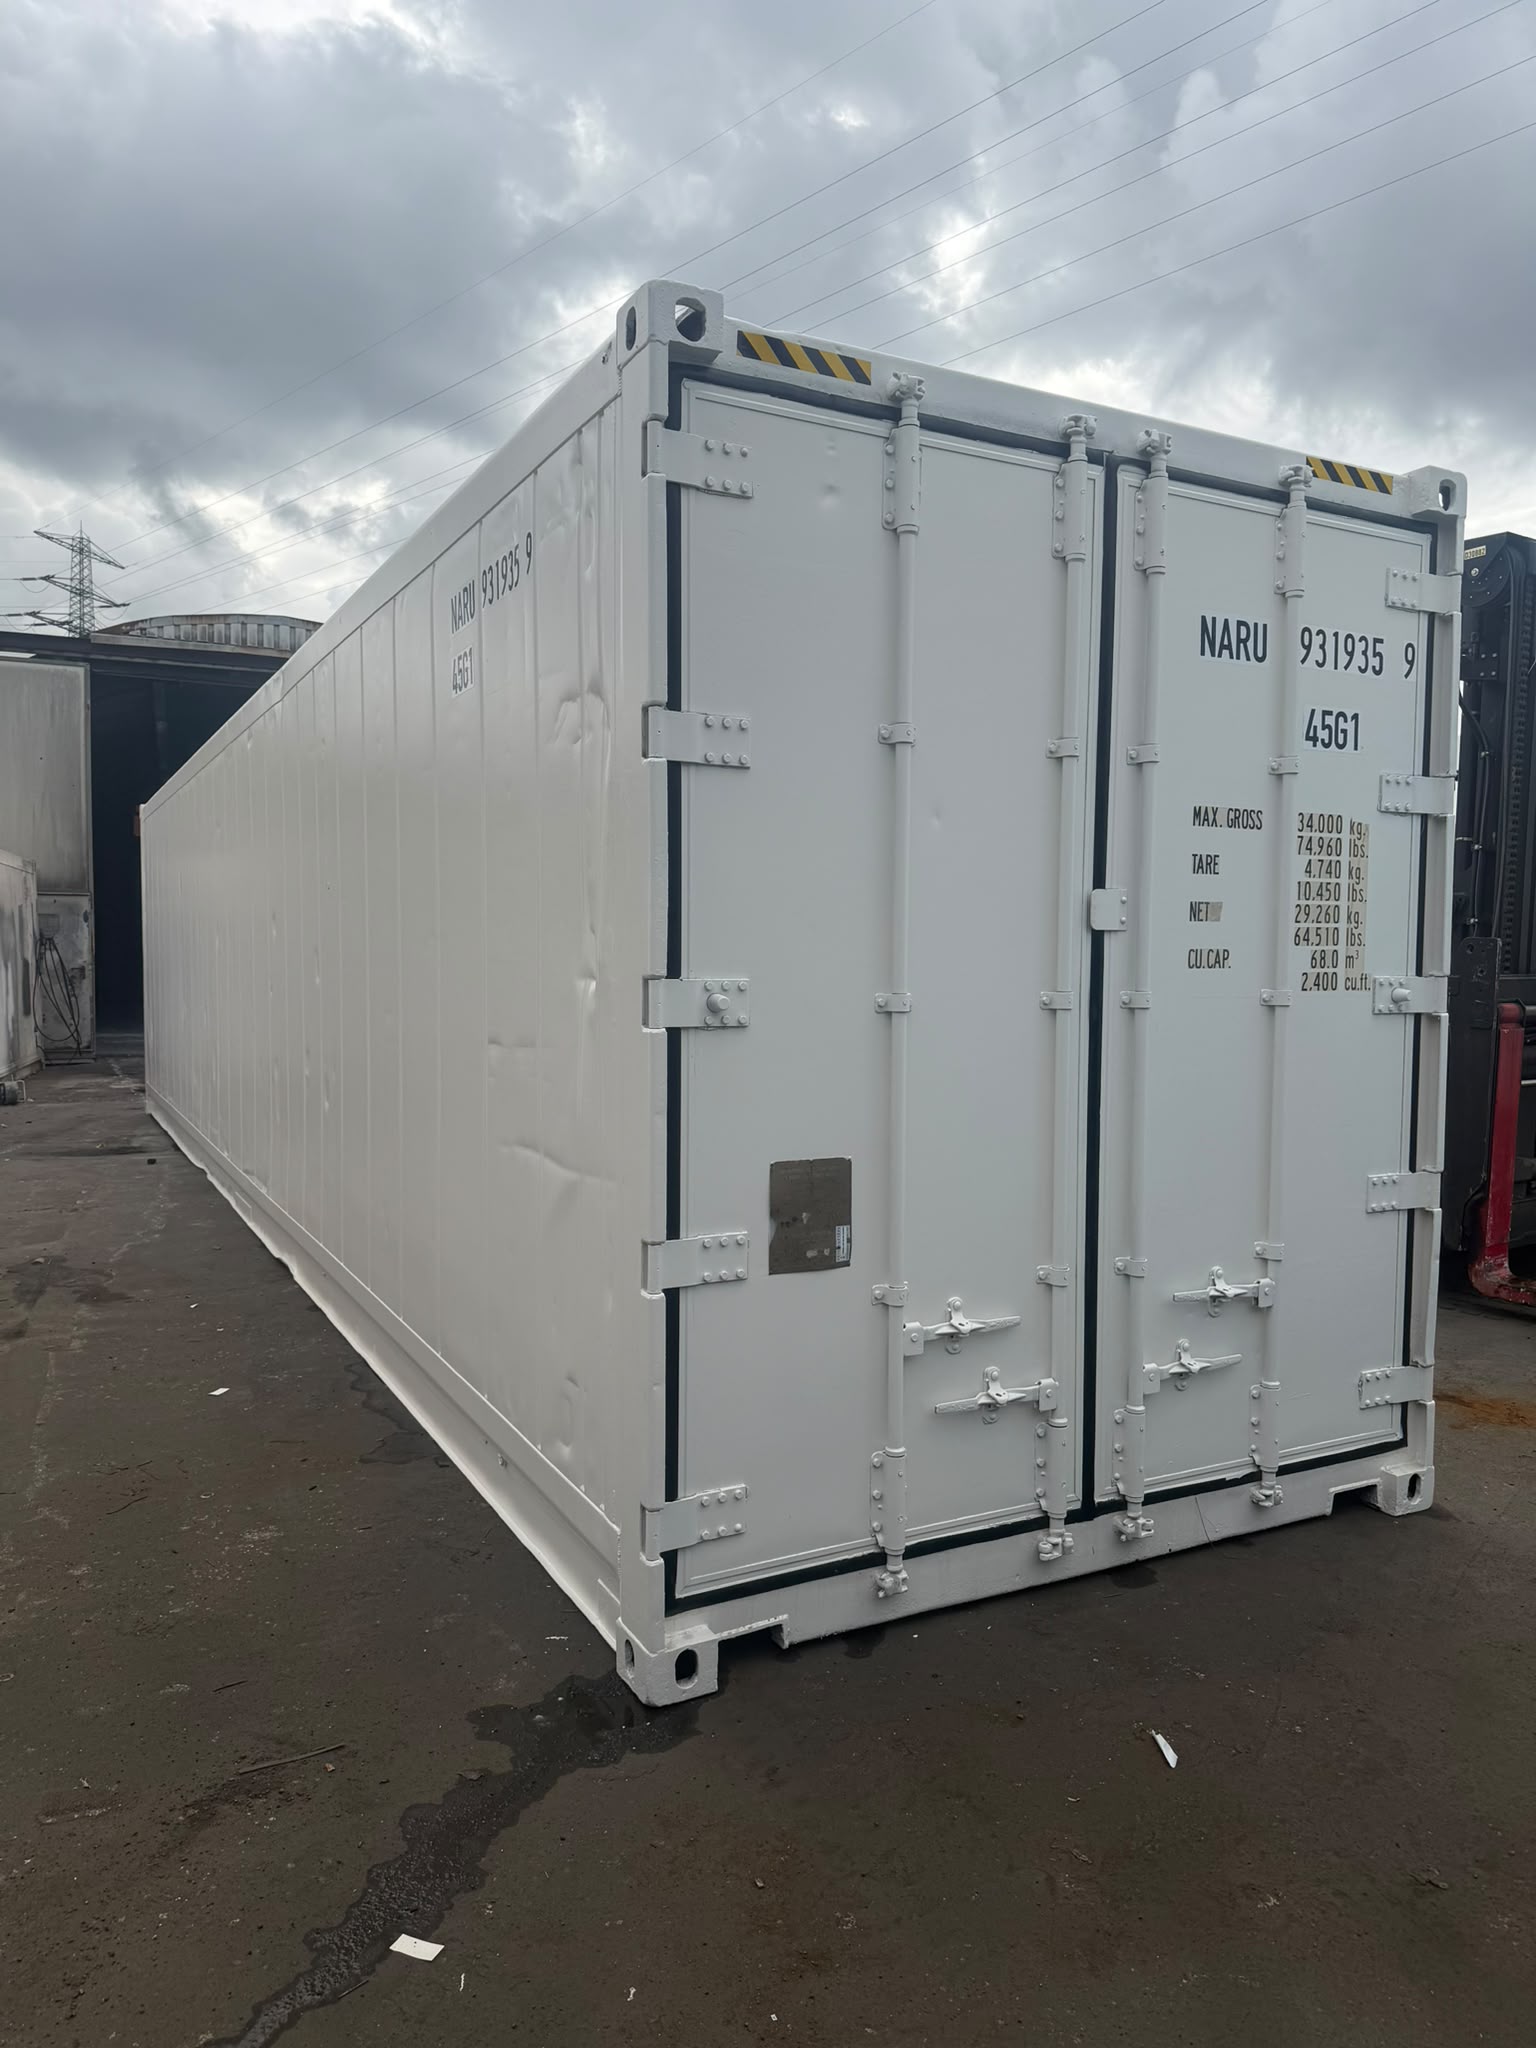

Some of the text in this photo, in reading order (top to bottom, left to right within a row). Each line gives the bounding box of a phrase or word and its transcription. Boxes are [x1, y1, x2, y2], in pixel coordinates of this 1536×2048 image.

[451, 532, 532, 634] NARU 931935 9
[1200, 615, 1416, 679] NARU 931935 9
[452, 647, 474, 694] 45G1
[1305, 708, 1360, 751] 45G1
[1193, 806, 1223, 828] MAX.
[1227, 808, 1263, 830] GROSS
[1350, 818, 1366, 840] kg.
[1349, 838, 1369, 858] lbs.
[1192, 854, 1220, 875] TARE
[1348, 861, 1364, 885] kg.
[1347, 883, 1367, 902] lbs.
[1189, 902, 1210, 922] NET
[1346, 905, 1363, 929] kg.
[1346, 928, 1366, 947] lbs.
[1310, 949, 1338, 969] 68.0
